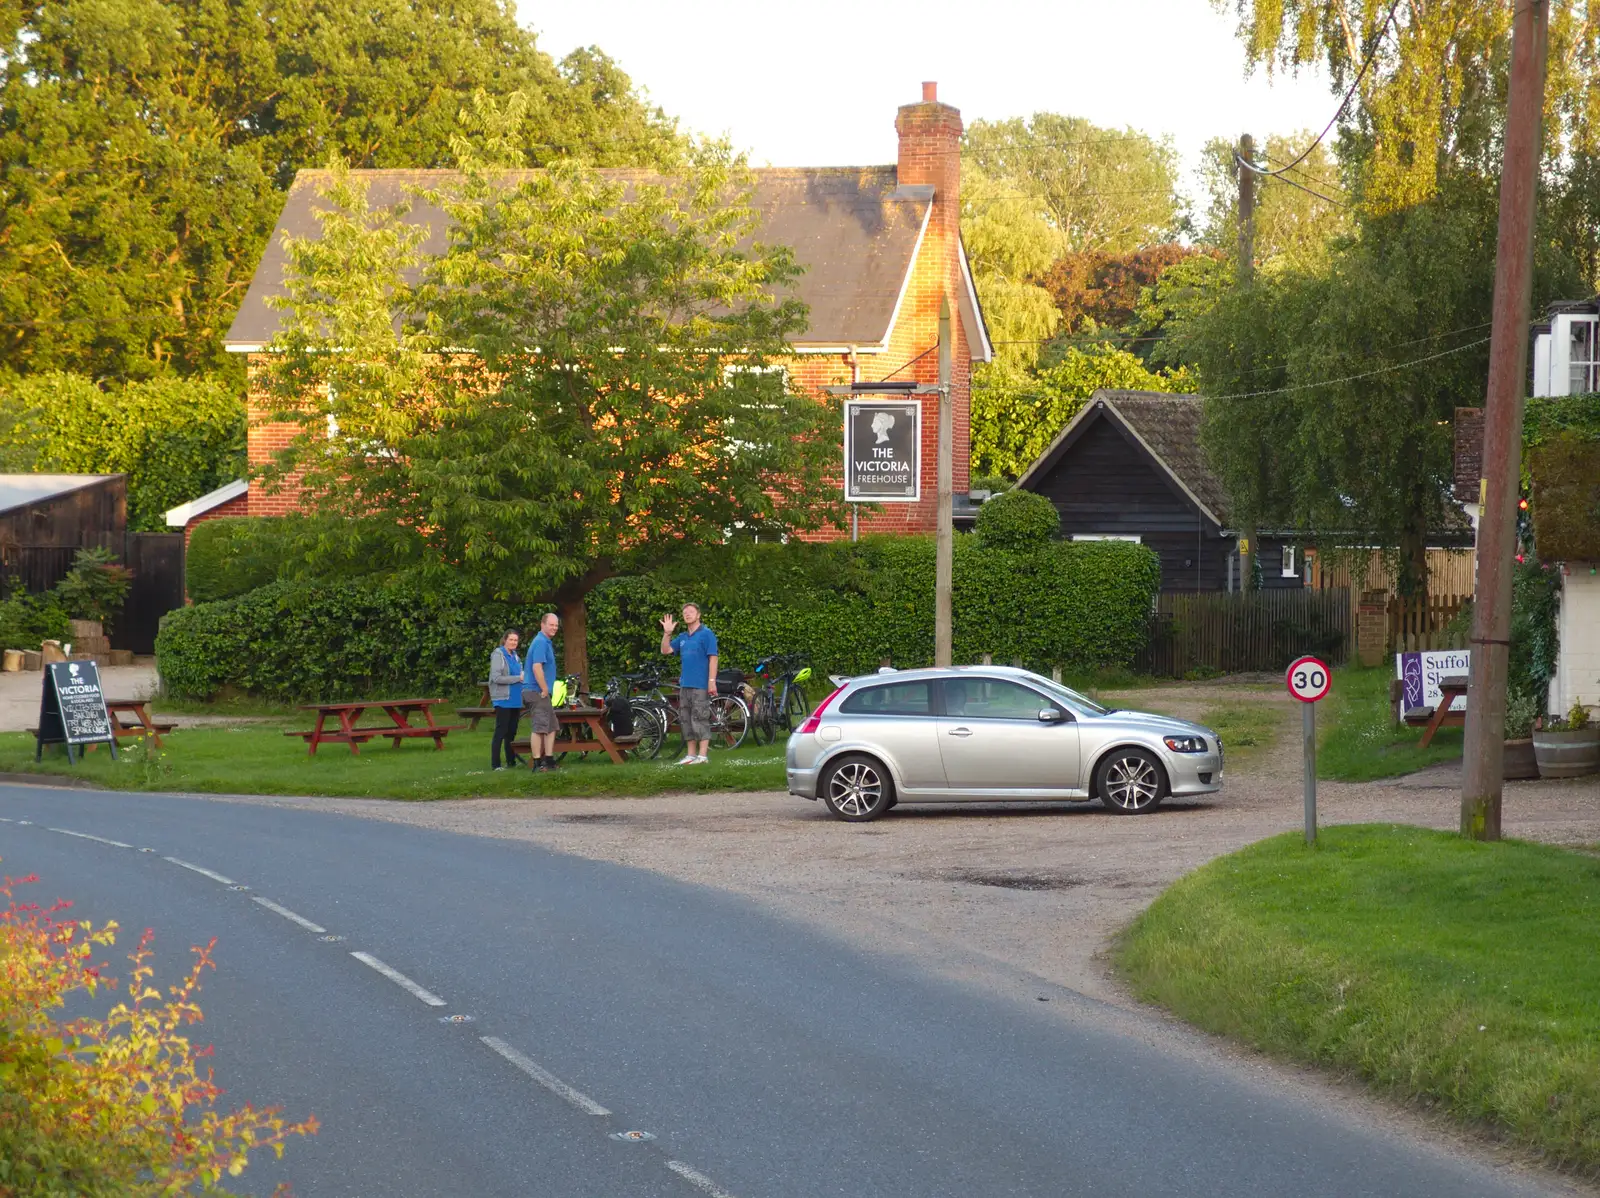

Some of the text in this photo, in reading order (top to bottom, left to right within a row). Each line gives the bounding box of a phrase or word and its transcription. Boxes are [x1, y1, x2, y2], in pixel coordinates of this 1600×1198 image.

[872, 447, 894, 458] THE
[855, 461, 910, 472] VICTORIA
[857, 474, 908, 484] FREEHOUSE
[1426, 655, 1469, 670] Suffol
[1294, 671, 1325, 689] 30
[58, 685, 99, 695] VICTORIA
[1427, 690, 1438, 698] 28
